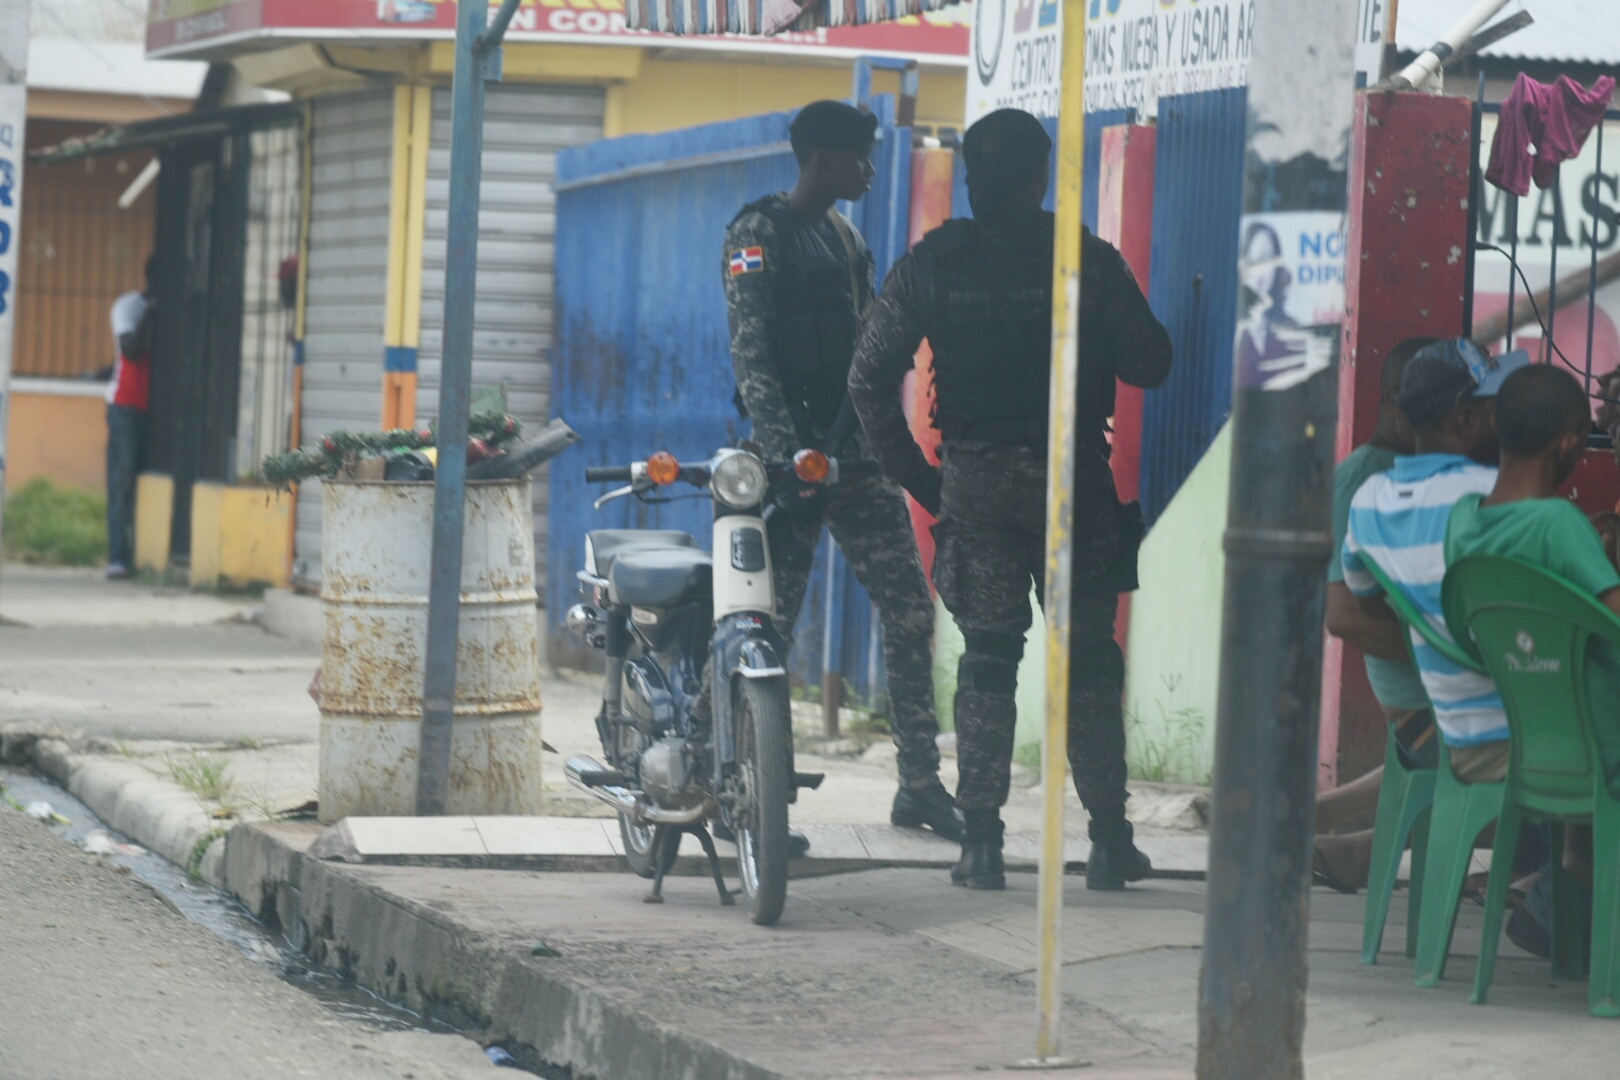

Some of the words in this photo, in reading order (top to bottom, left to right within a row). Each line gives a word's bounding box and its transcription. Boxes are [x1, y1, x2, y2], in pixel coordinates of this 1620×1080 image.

[1010, 35, 1056, 91] CENTRO
[1165, 12, 1178, 69] Y
[1181, 3, 1229, 68] USADA
